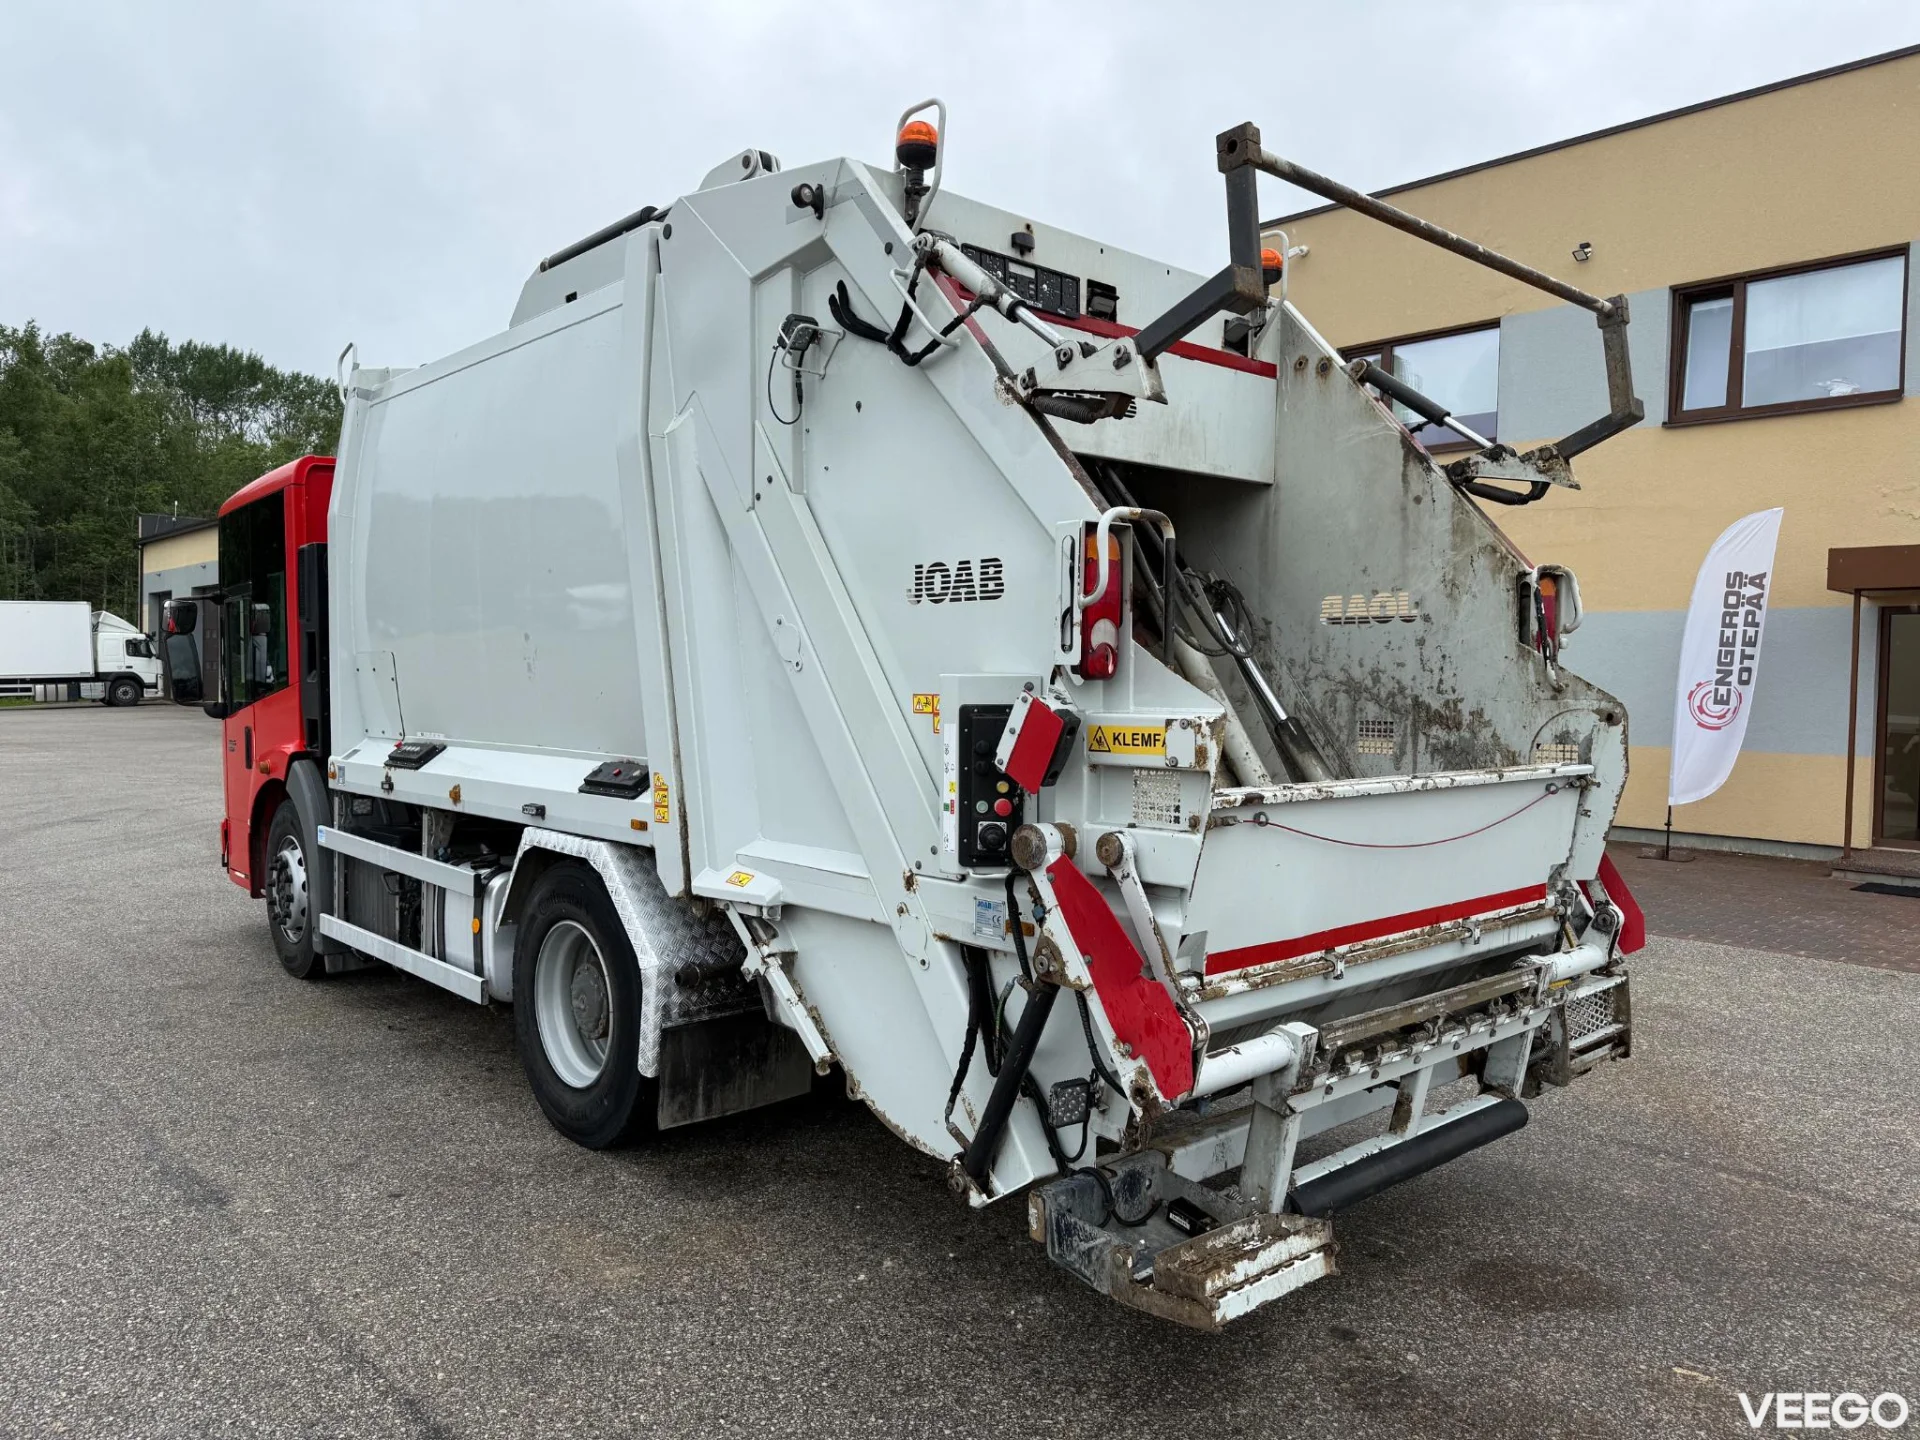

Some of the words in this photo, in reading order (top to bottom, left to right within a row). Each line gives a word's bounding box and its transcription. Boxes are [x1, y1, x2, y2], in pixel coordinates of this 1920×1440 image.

[906, 557, 1004, 605] JOAB
[1713, 571, 1744, 706] ENGEROS
[1737, 571, 1767, 686] OTEPÄÄ
[1113, 732, 1166, 748] KLEMF
